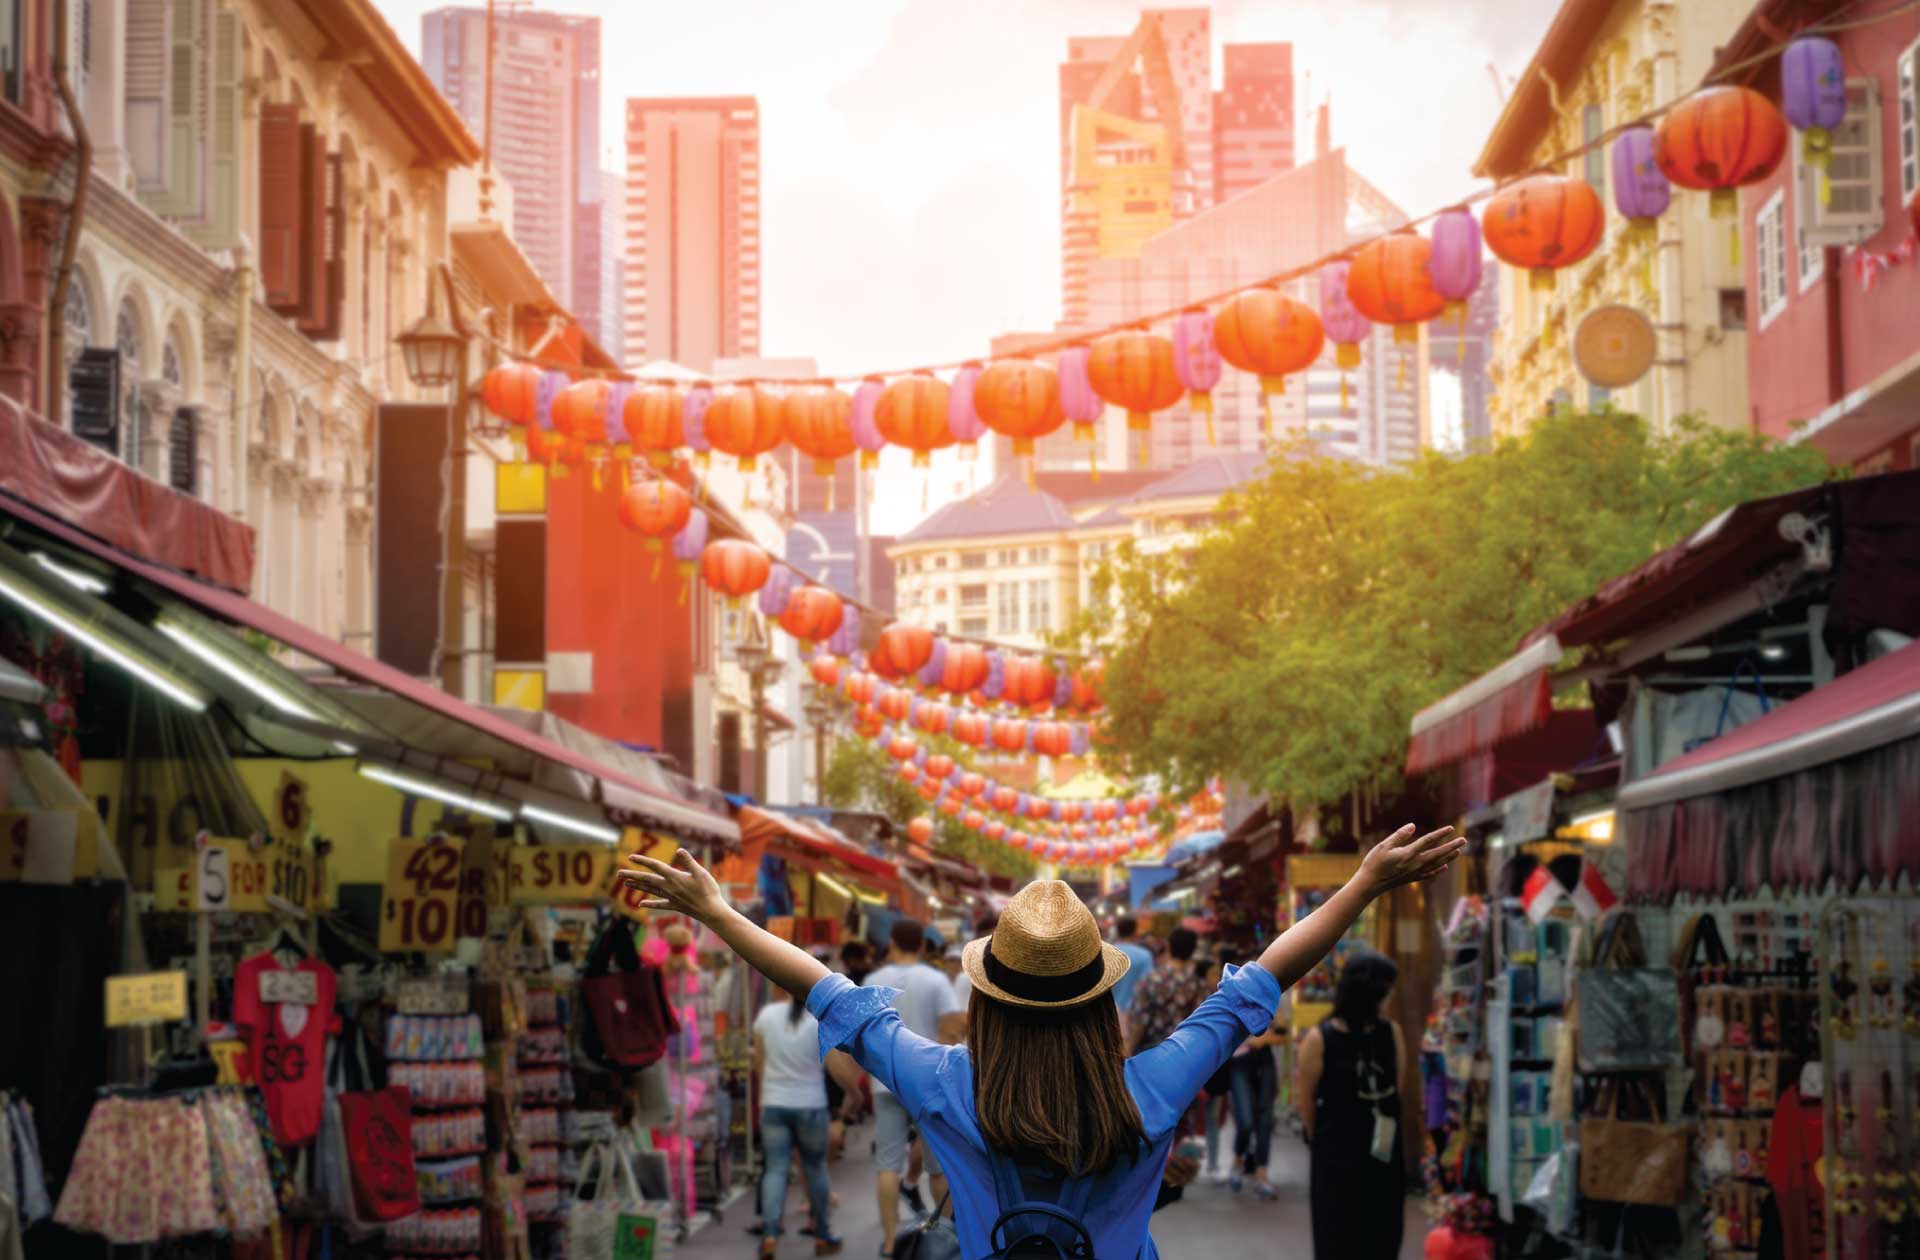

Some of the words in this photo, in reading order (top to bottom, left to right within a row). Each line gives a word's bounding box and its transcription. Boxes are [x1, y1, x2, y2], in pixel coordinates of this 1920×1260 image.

[282, 783, 302, 829] 6
[203, 848, 227, 904] 5
[231, 861, 266, 897] FOR
[272, 855, 308, 908] $10
[404, 846, 460, 891] 42
[531, 850, 594, 887] $10
[263, 1043, 309, 1083] SG
